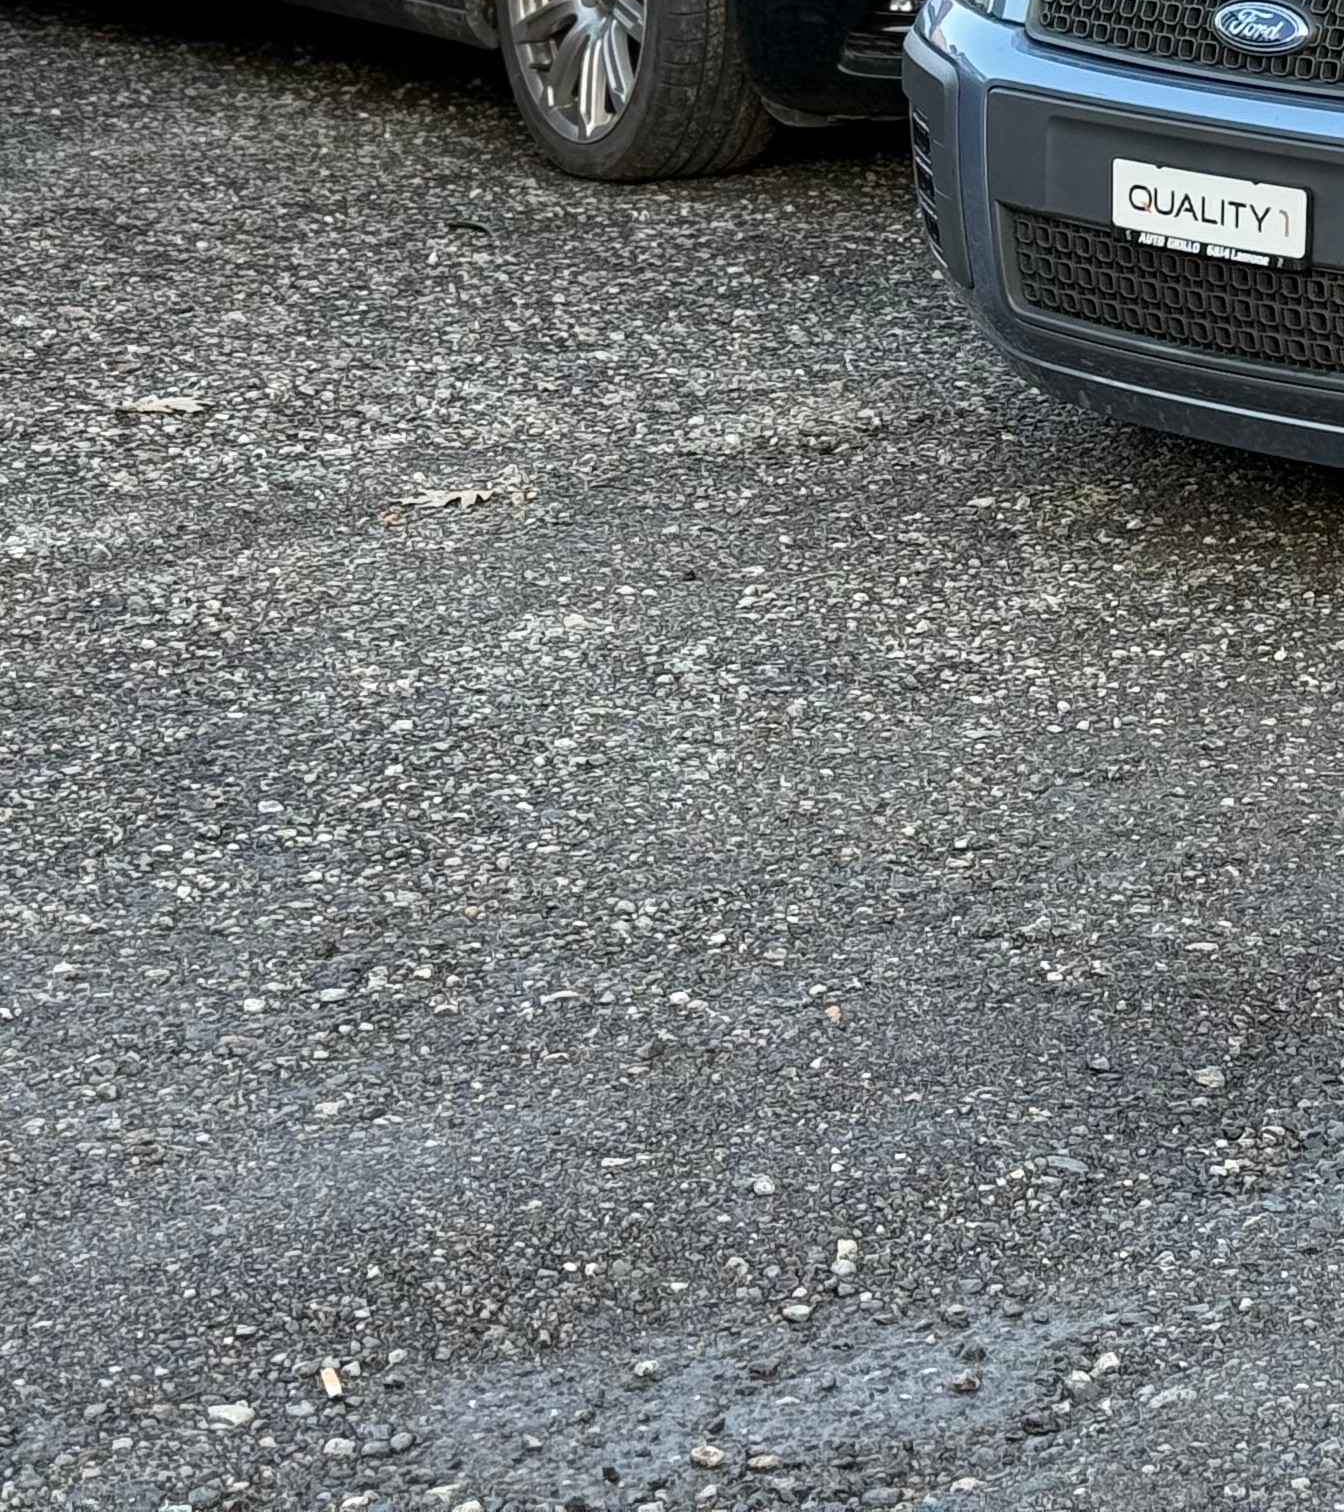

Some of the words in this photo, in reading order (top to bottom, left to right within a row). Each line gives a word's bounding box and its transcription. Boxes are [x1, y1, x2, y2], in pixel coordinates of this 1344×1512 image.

[1229, 8, 1284, 40] Ford
[1129, 184, 1272, 233] QUALITY
[1278, 209, 1290, 238] 1
[1138, 232, 1165, 247] AUTO
